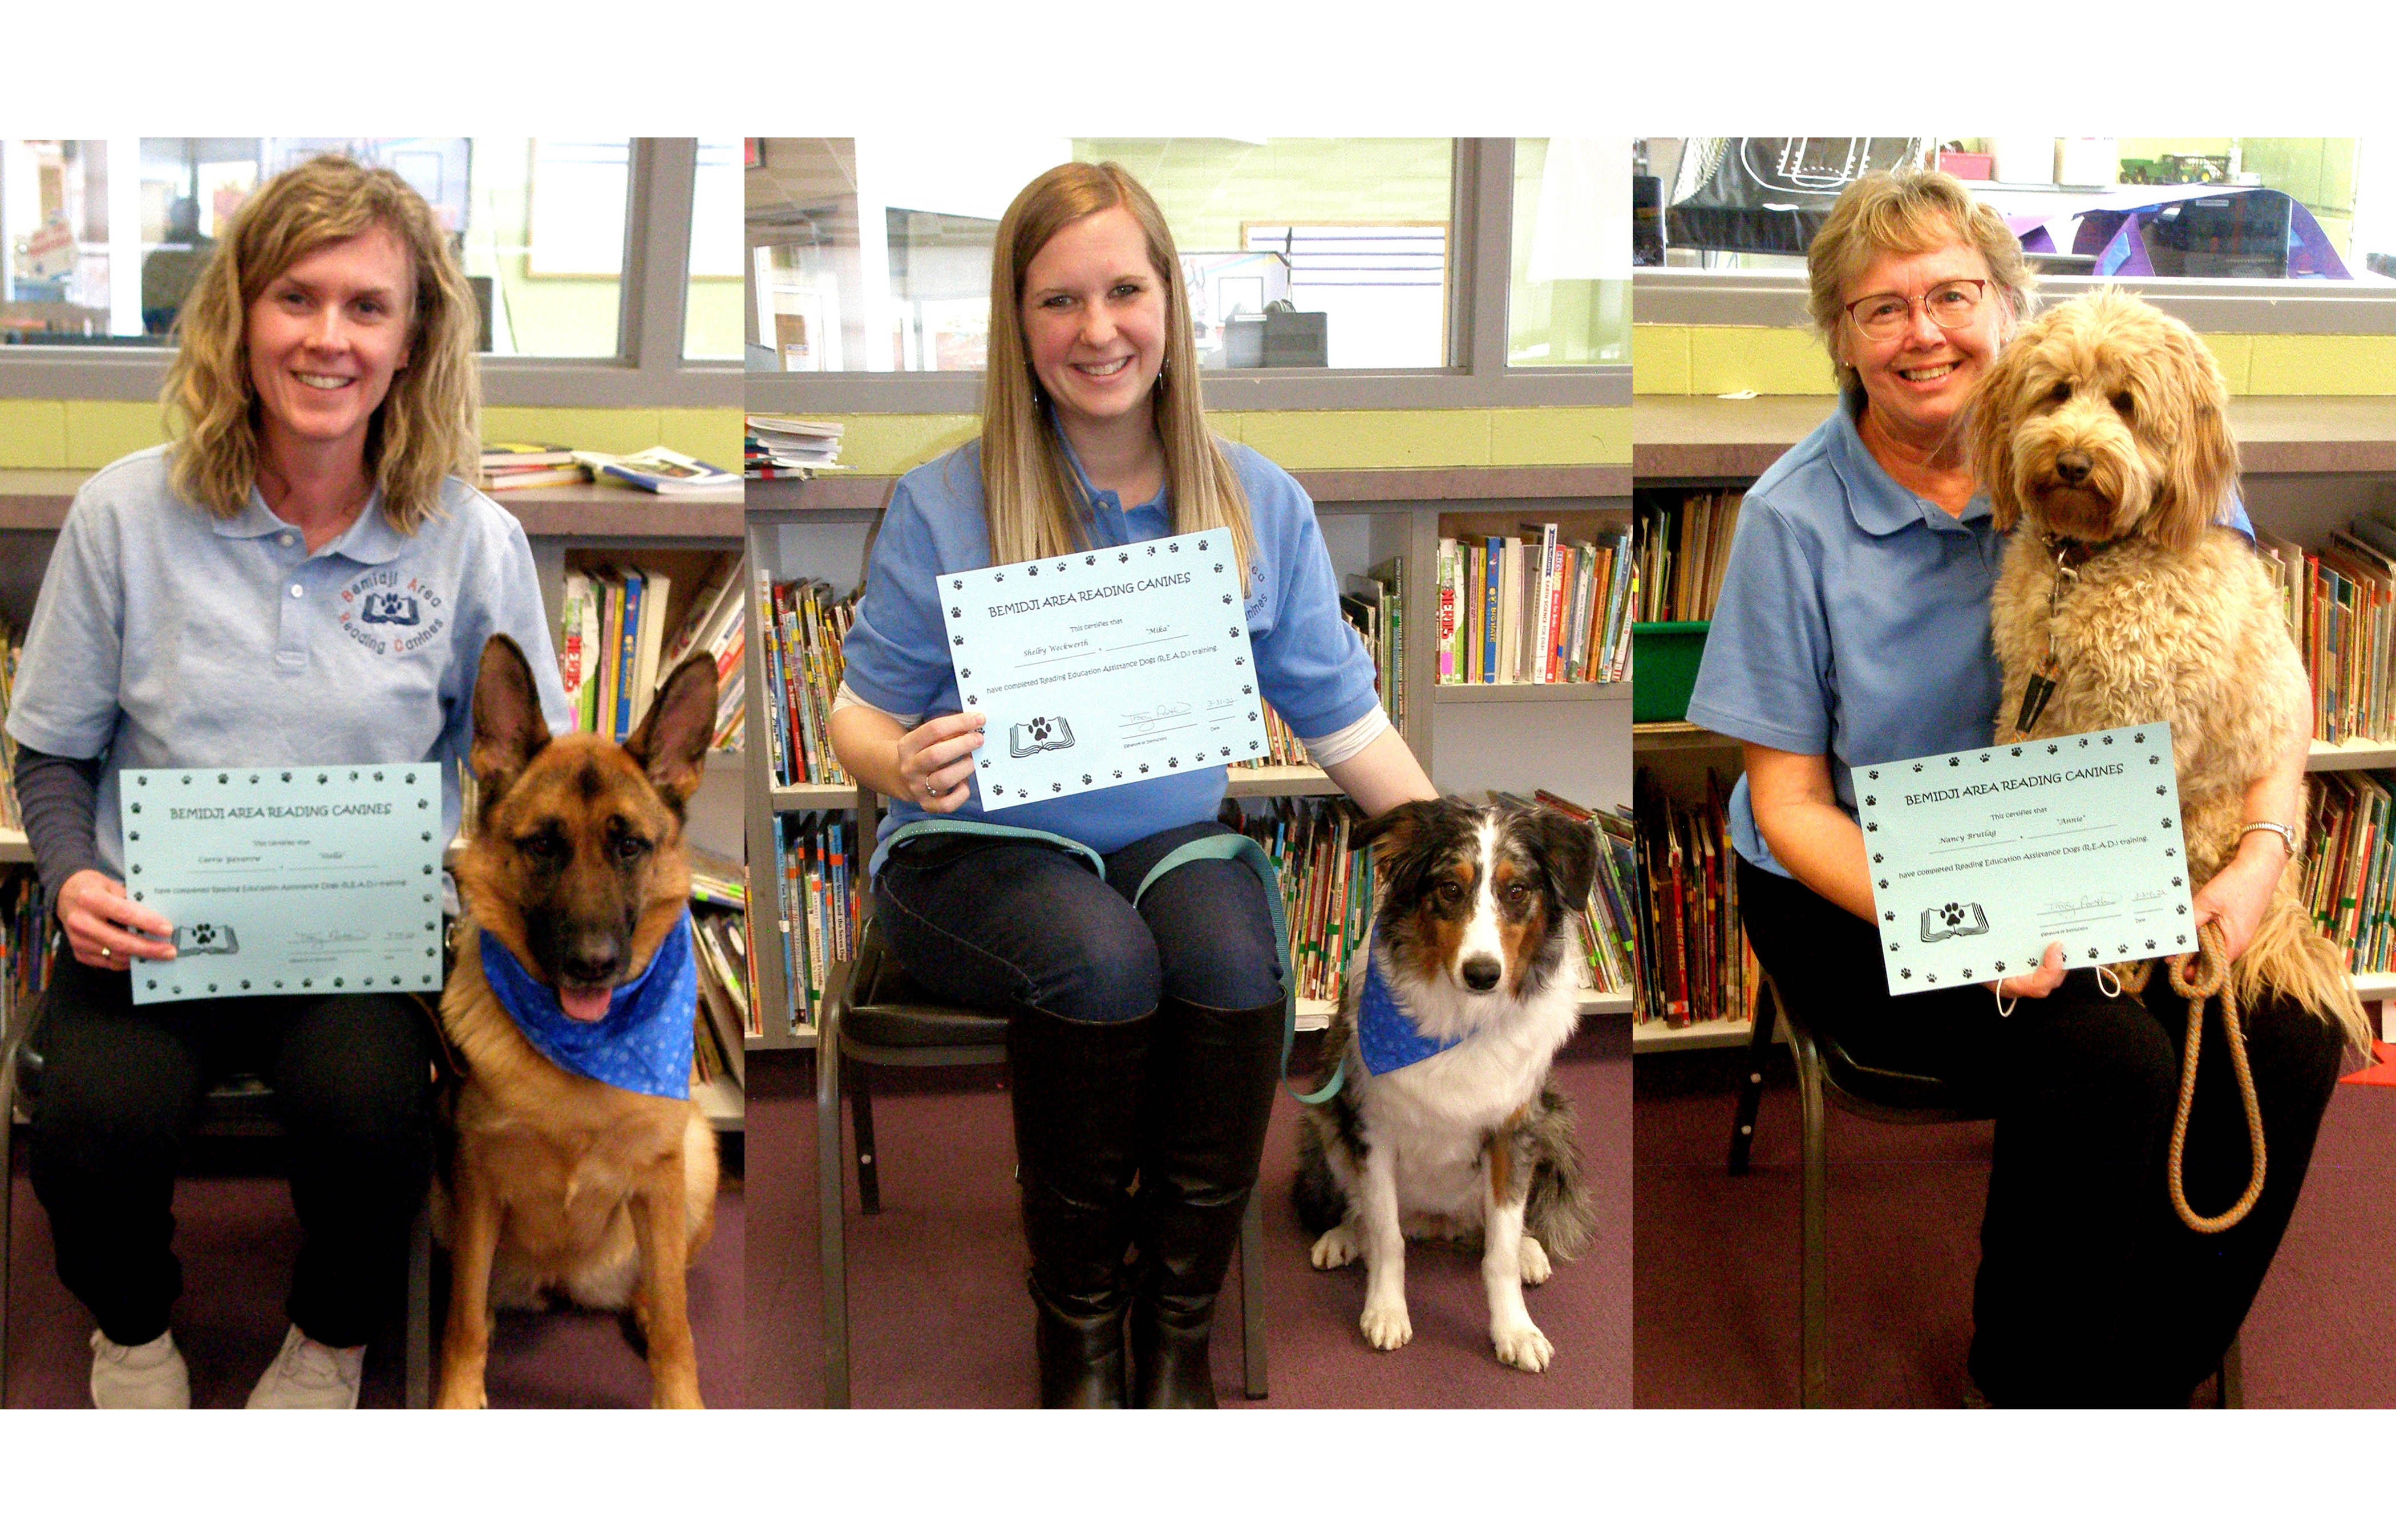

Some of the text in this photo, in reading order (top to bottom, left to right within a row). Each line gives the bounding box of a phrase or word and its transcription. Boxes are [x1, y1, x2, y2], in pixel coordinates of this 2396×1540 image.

[1252, 566, 1265, 582] ea
[341, 570, 442, 607] Bemidji Area
[987, 572, 1191, 618] BEMIDJI AREA READING CANINES
[1245, 594, 1267, 621] nines
[1441, 589, 1454, 640] NERDS
[394, 618, 444, 652] Canines
[1084, 621, 1109, 630] certifies
[1146, 625, 1170, 634] "Mika"
[1023, 639, 1088, 656] Shelby Weckwerth
[986, 686, 1002, 694] have
[1003, 679, 1039, 691] completed
[1039, 674, 1066, 684] Reading
[1067, 668, 1102, 680] Education
[1102, 660, 1138, 672] Assistance
[1139, 657, 1156, 666] Dogs
[1904, 763, 2124, 806] BEMIDJI AREA READING CANINES
[169, 803, 392, 820] BEMIDJI AREA READING CANINES
[2005, 809, 2032, 818] certifies
[1916, 865, 1954, 876] completed
[1954, 861, 1984, 871] Reading
[1984, 856, 2022, 867] Education
[2023, 849, 2061, 860] Assistance
[2062, 846, 2081, 855] Dogs
